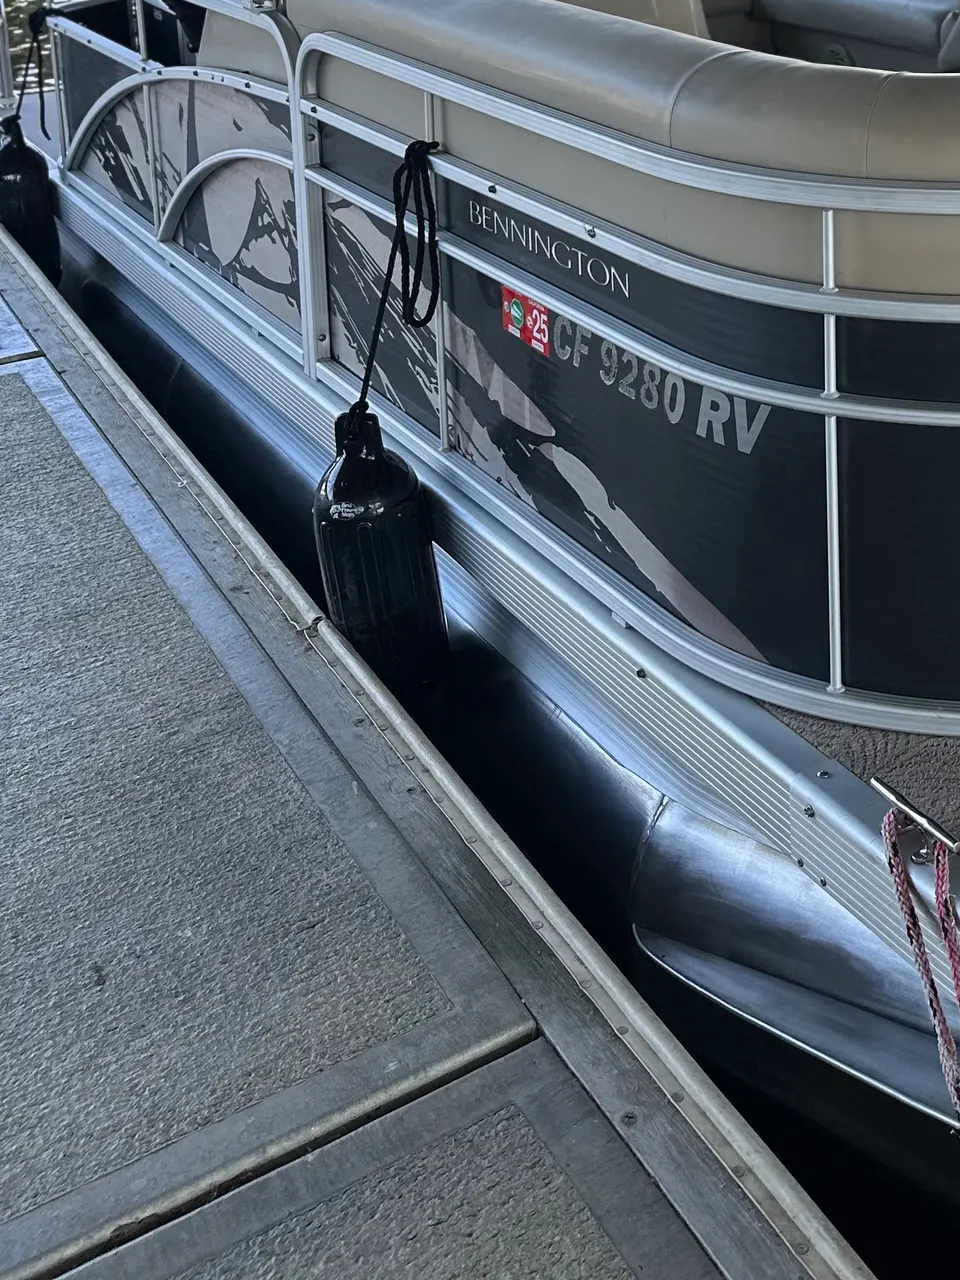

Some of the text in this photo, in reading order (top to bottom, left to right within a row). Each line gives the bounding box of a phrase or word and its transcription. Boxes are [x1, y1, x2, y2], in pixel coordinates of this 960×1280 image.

[469, 200, 631, 298] BENNINGTON
[532, 309, 549, 343] 25
[553, 315, 772, 455] CF 9280 RV
